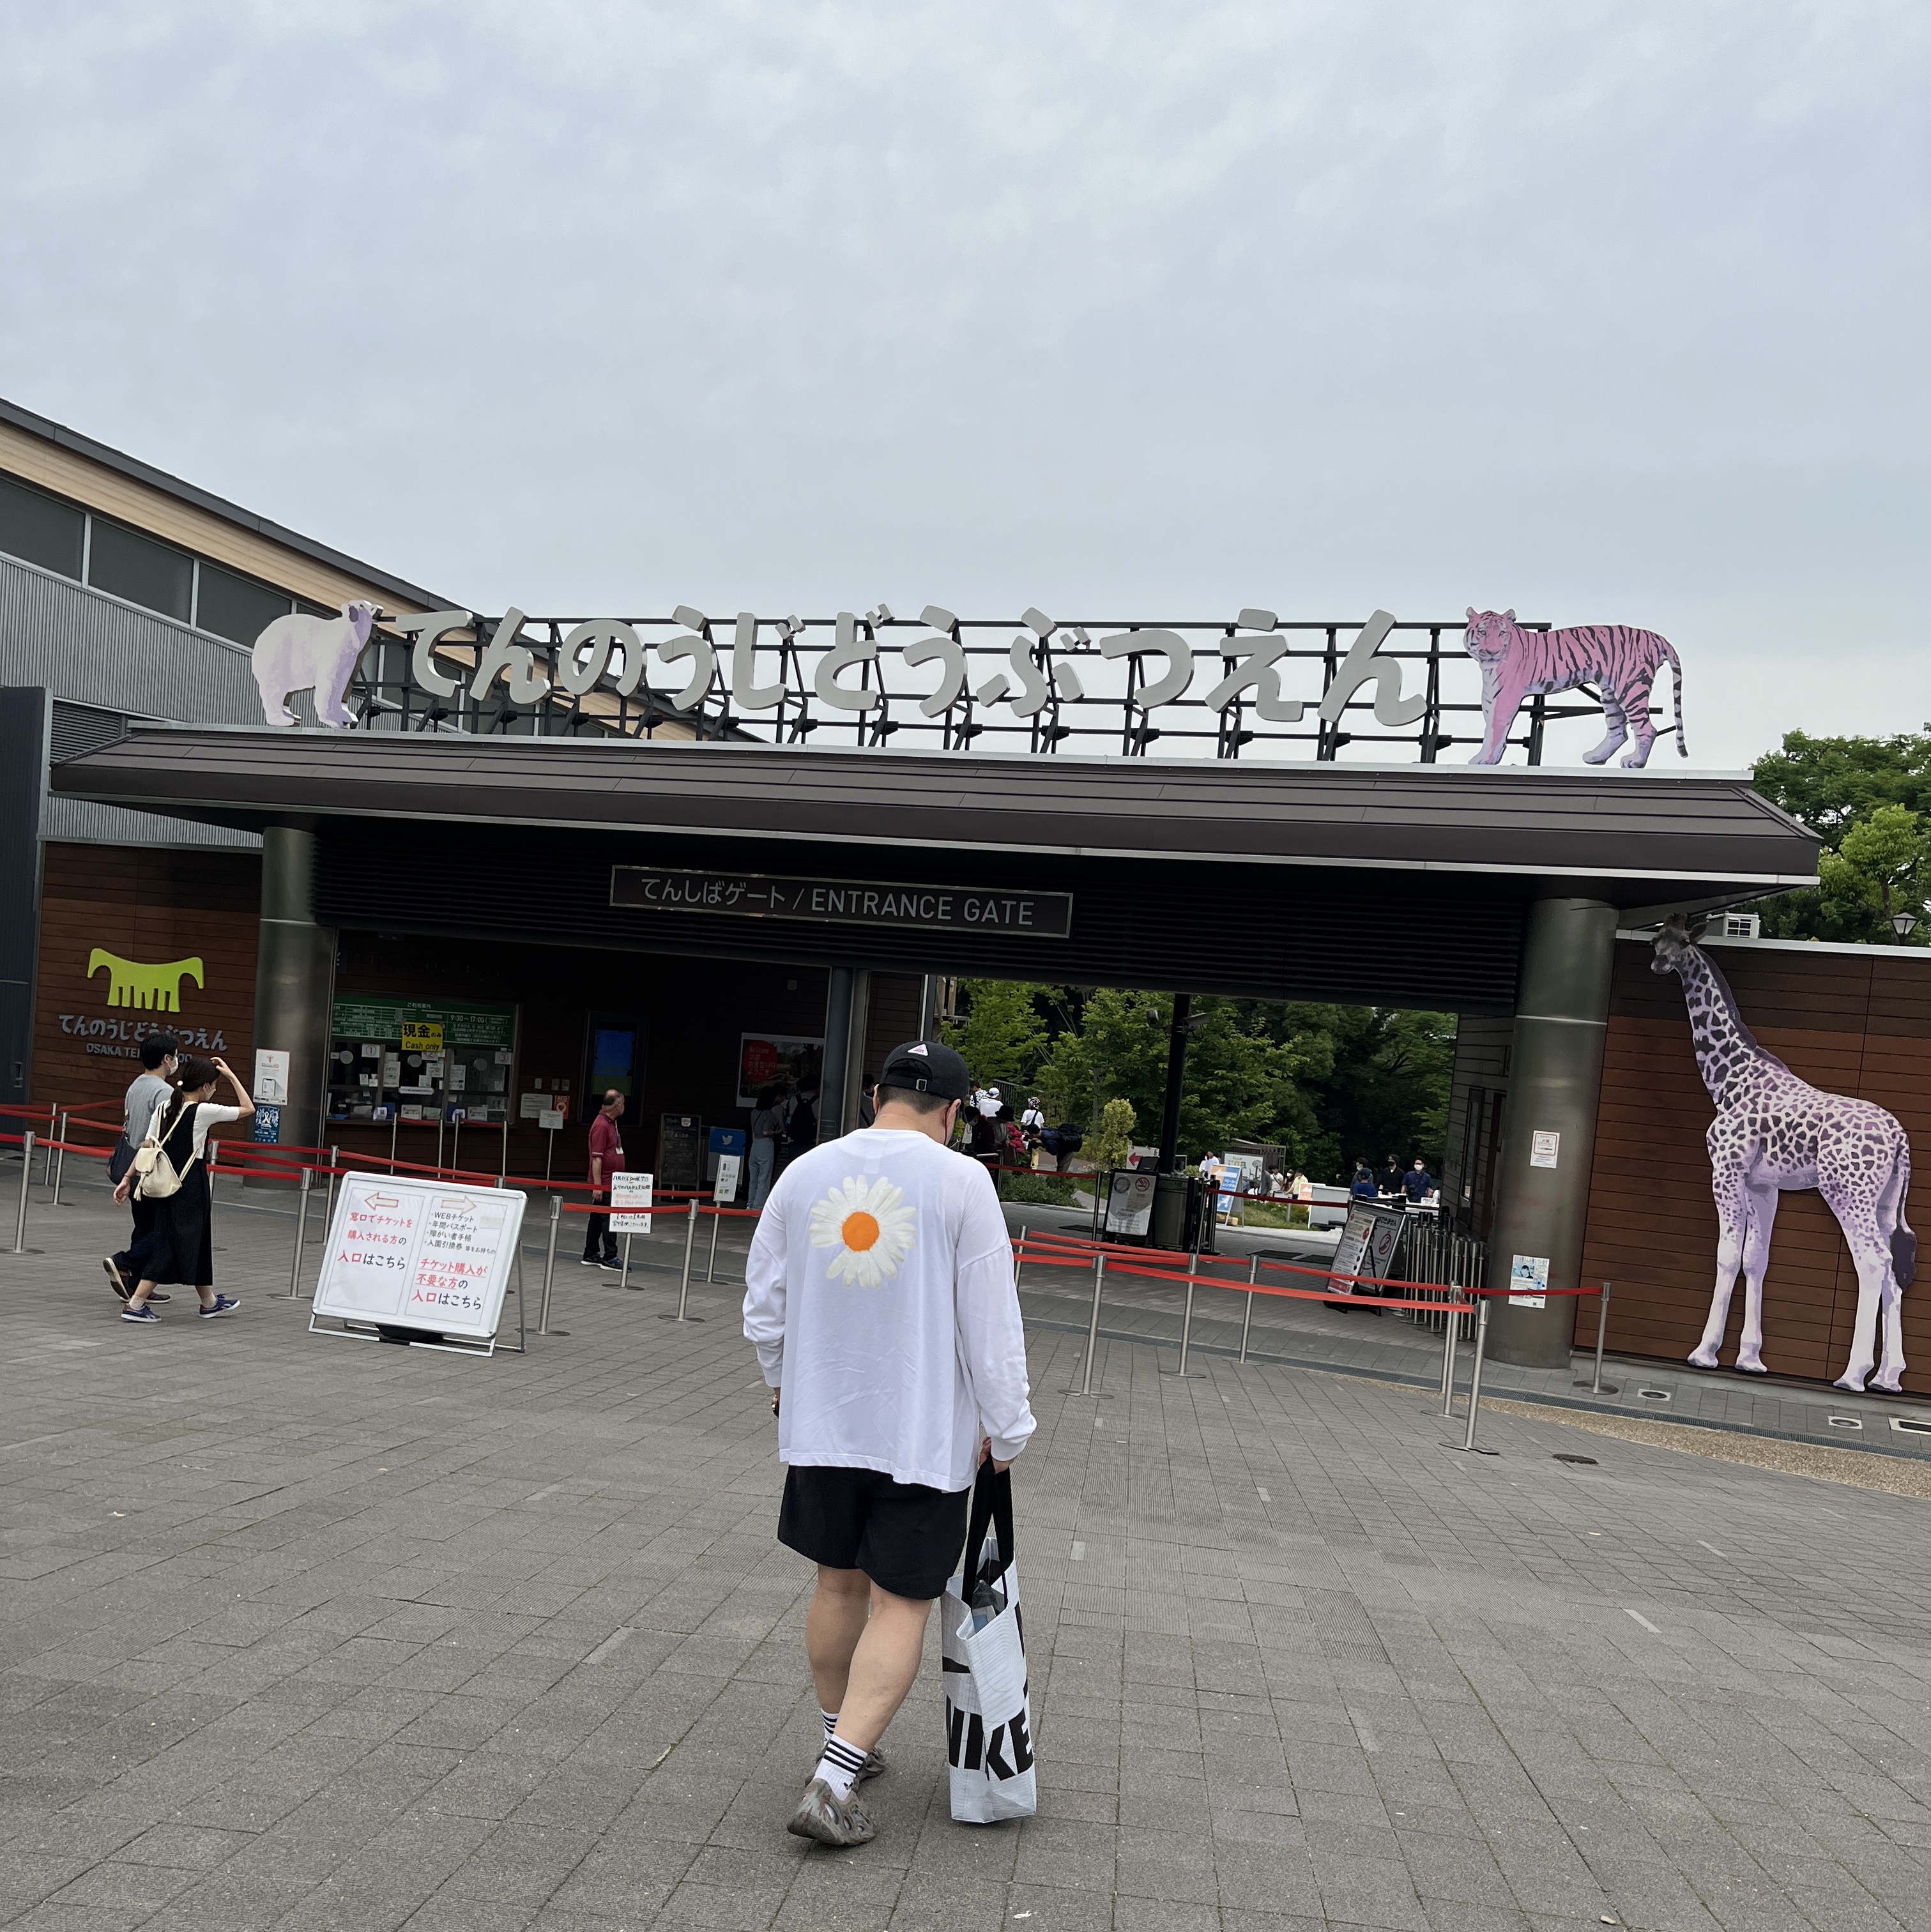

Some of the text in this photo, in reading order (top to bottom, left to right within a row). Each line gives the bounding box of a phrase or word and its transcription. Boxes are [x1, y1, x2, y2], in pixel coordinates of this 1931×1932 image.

[395, 603, 1428, 727] てんのうじどうぶつえん
[641, 877, 786, 909] てんしばゲート
[812, 888, 952, 920] ENTRANCE
[963, 897, 1035, 926] GATE
[403, 1024, 442, 1038] 現金のみ
[86, 1043, 120, 1056] OSAKA
[406, 1040, 440, 1051] Cash only
[350, 1212, 413, 1228] 窓口でチケットを
[347, 1229, 407, 1245] 購入される方の
[337, 1249, 406, 1270] 入口はこちら
[416, 1274, 468, 1289] 不要な方の
[411, 1289, 482, 1310] 入口はこちら
